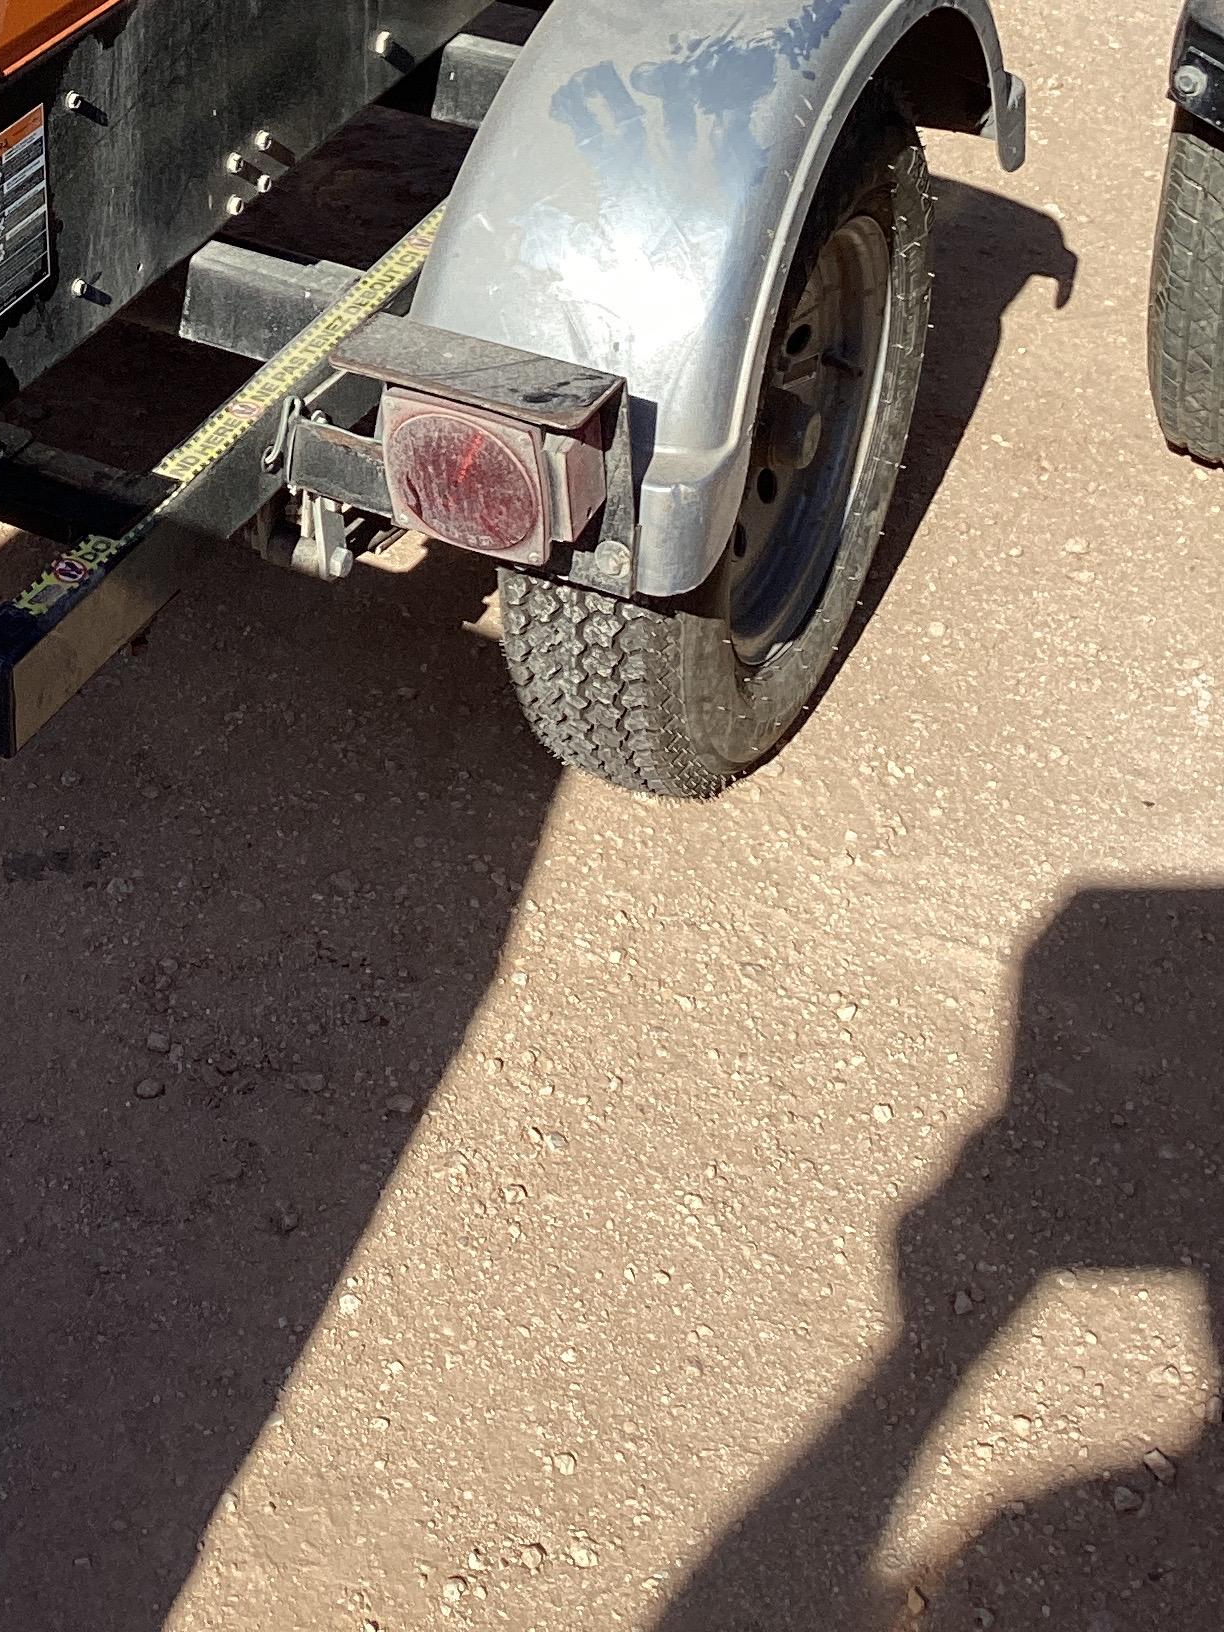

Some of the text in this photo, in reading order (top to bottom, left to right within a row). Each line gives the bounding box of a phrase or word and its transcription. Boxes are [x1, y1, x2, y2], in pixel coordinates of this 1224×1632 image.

[198, 417, 244, 456] HERE
[250, 381, 277, 402] NE
[276, 355, 308, 382] PAS
[300, 316, 346, 355] TENEZ
[346, 268, 402, 316] DEBOUT
[398, 250, 421, 267] ICI
[77, 540, 112, 563] DO
